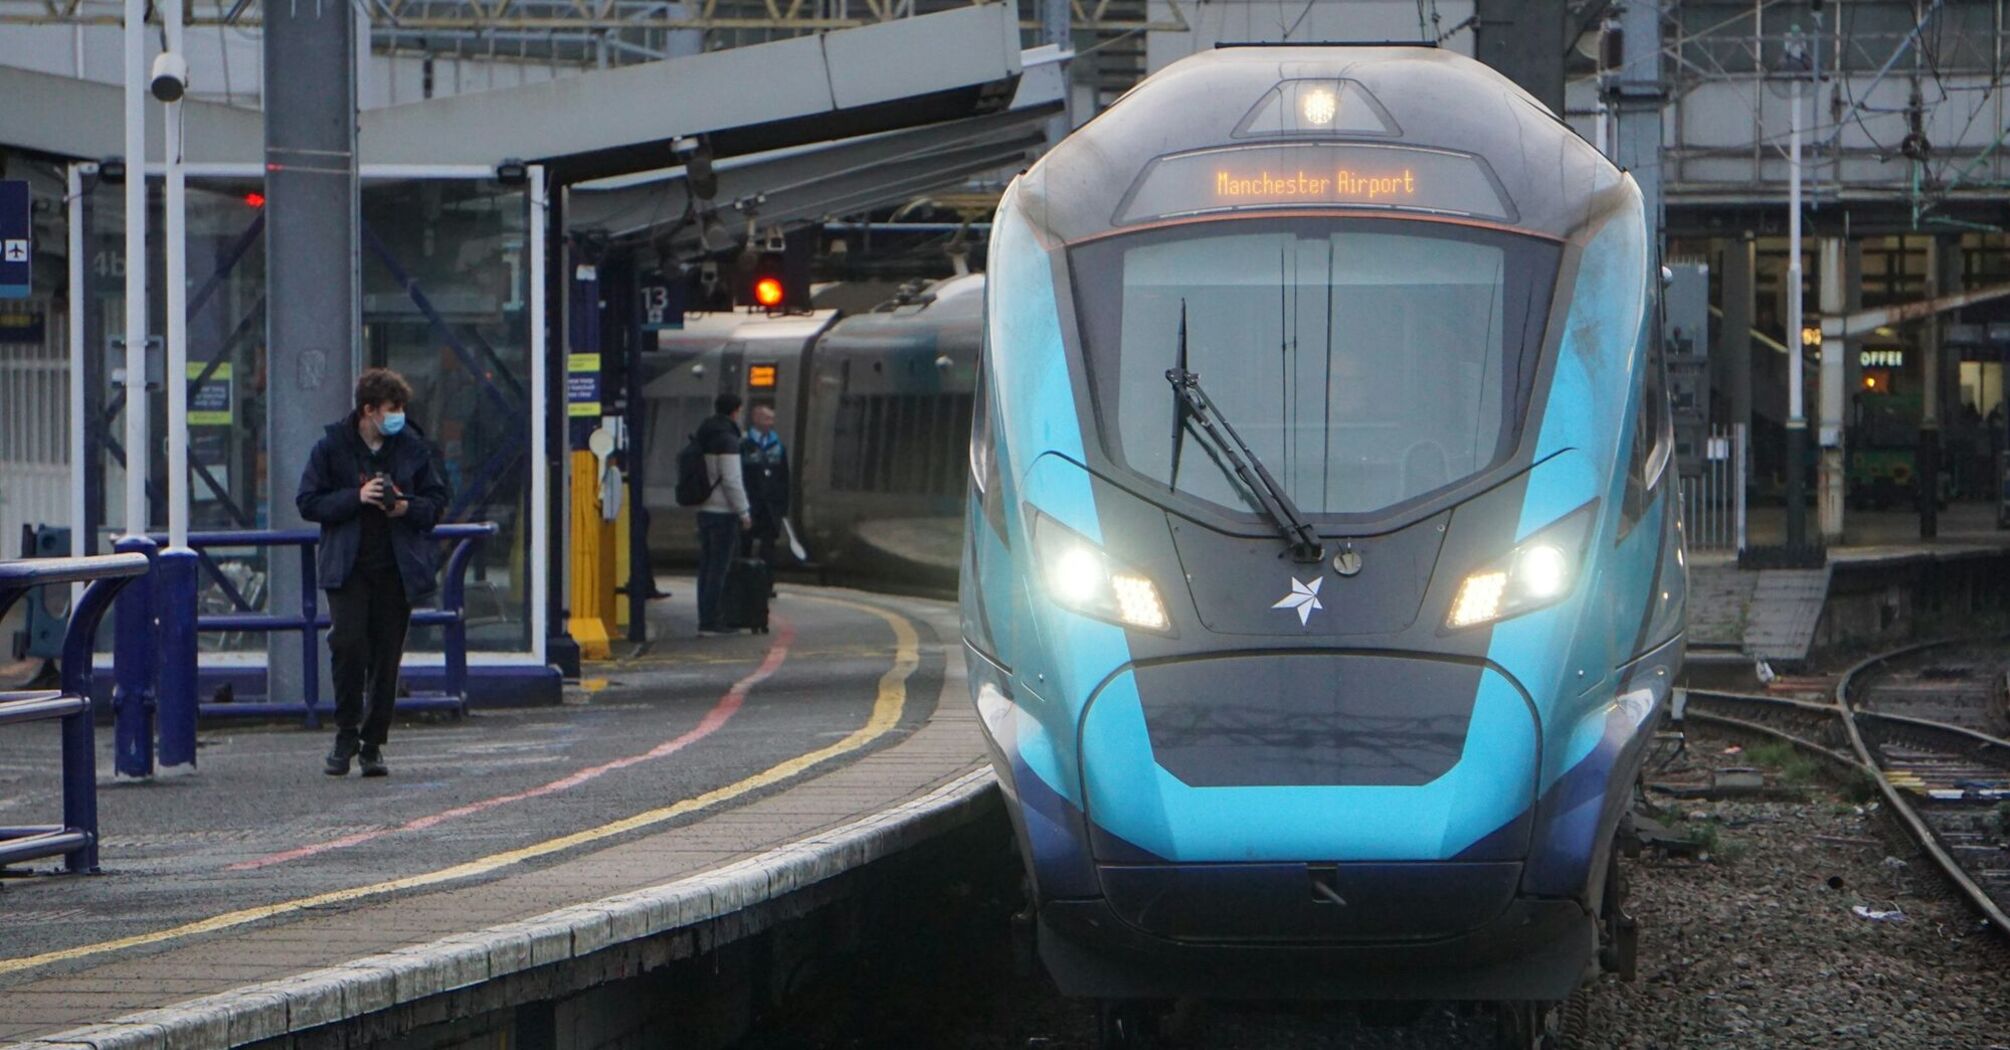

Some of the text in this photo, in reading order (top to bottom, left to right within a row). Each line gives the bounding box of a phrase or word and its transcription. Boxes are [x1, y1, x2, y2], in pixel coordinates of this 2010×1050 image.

[1216, 169, 1415, 199] Manchester Airport
[639, 285, 669, 310] 13
[1859, 350, 1903, 367] OFFEE
